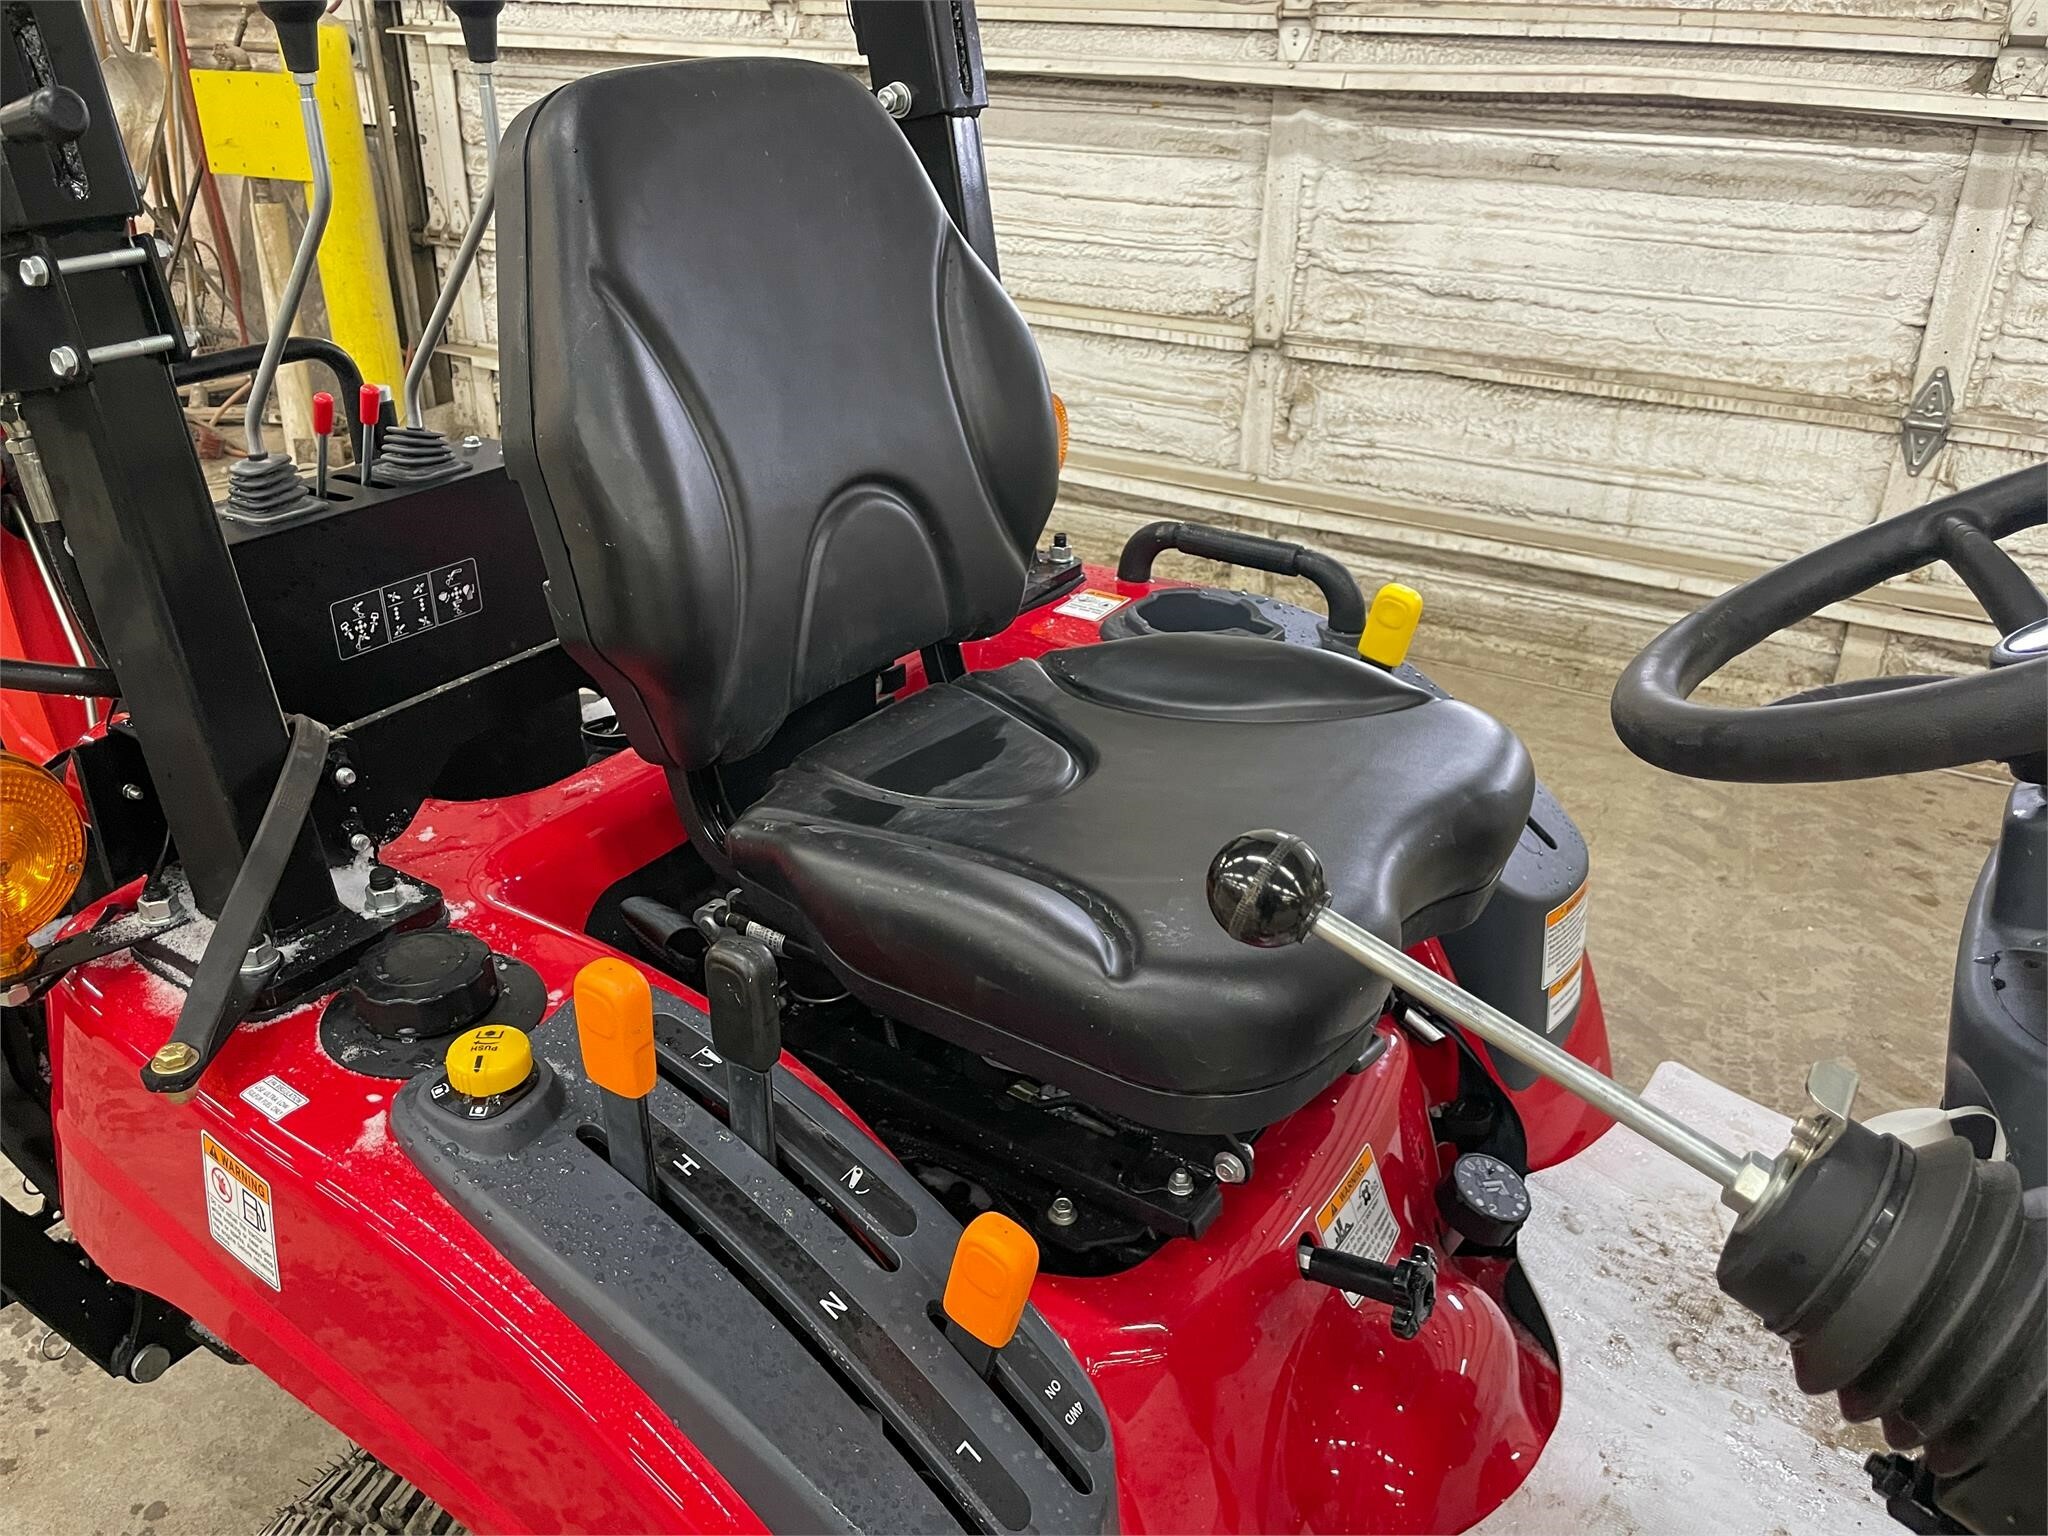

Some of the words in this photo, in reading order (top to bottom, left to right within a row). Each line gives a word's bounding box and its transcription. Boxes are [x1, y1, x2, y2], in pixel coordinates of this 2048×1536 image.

[221, 1152, 266, 1198] WARNING
[673, 1153, 700, 1176] H
[1489, 1204, 1498, 1215] 2
[819, 1291, 848, 1320] N
[1044, 1380, 1060, 1400] ON
[1064, 1401, 1084, 1426] 4WD
[956, 1440, 982, 1463] L
